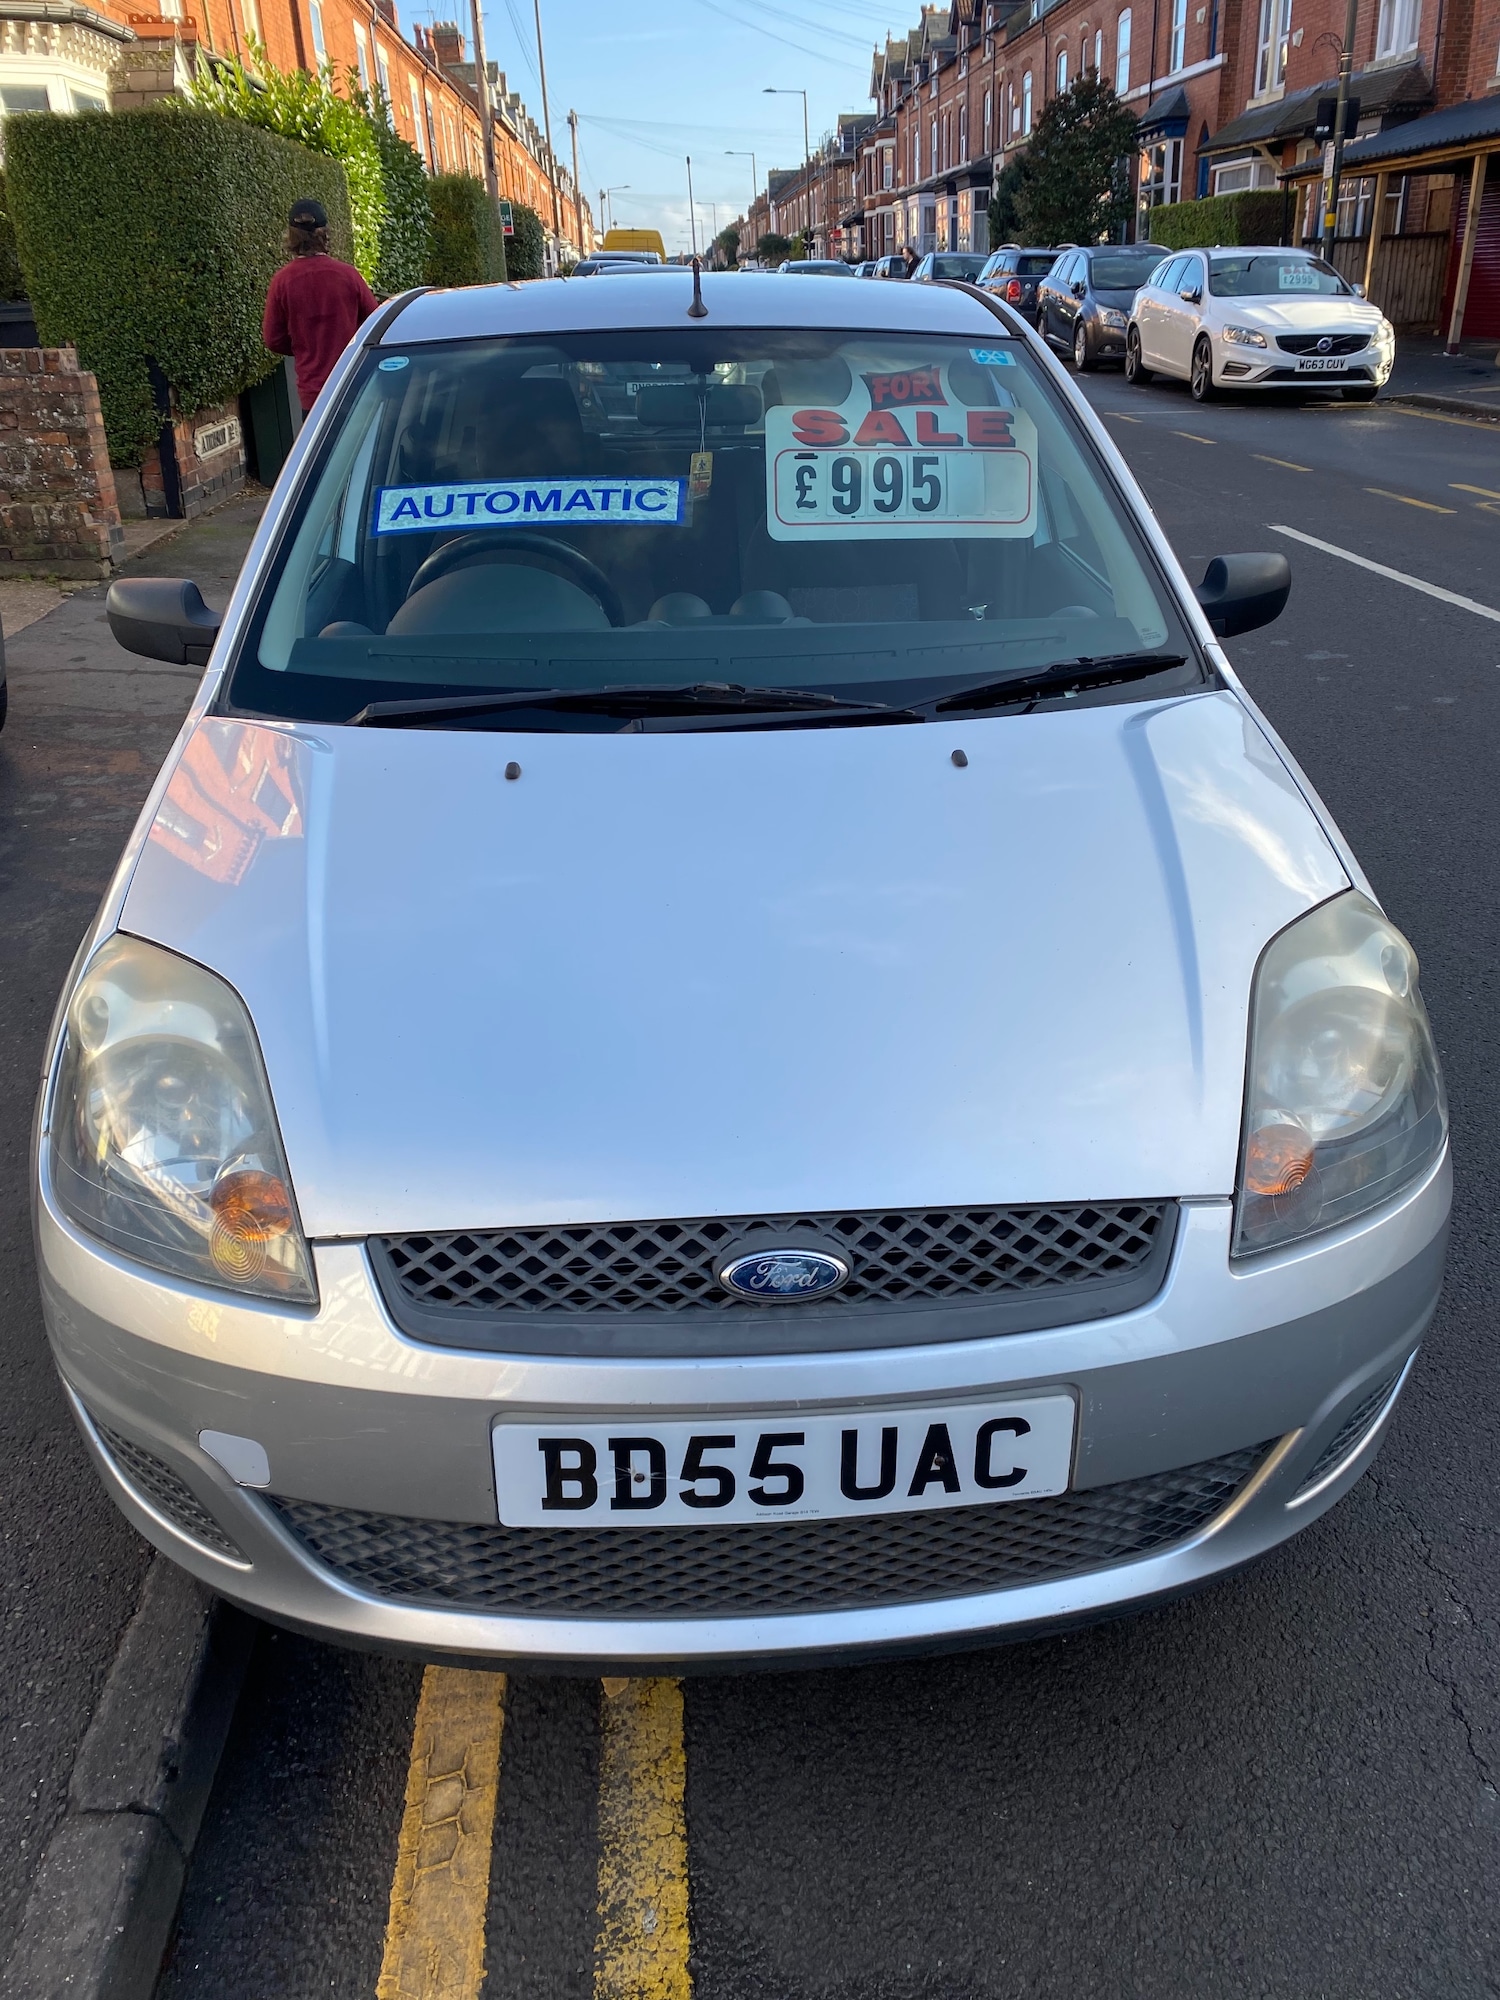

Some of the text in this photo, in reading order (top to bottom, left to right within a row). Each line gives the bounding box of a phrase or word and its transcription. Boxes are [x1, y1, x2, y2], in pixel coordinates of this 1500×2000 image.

[872, 371, 933, 403] FOR
[792, 409, 1016, 447] SALE
[794, 456, 942, 515] £995
[390, 488, 669, 521] AUTOMATIC
[749, 1261, 819, 1289] Ford
[537, 1416, 1032, 1511] BD55 UAC
